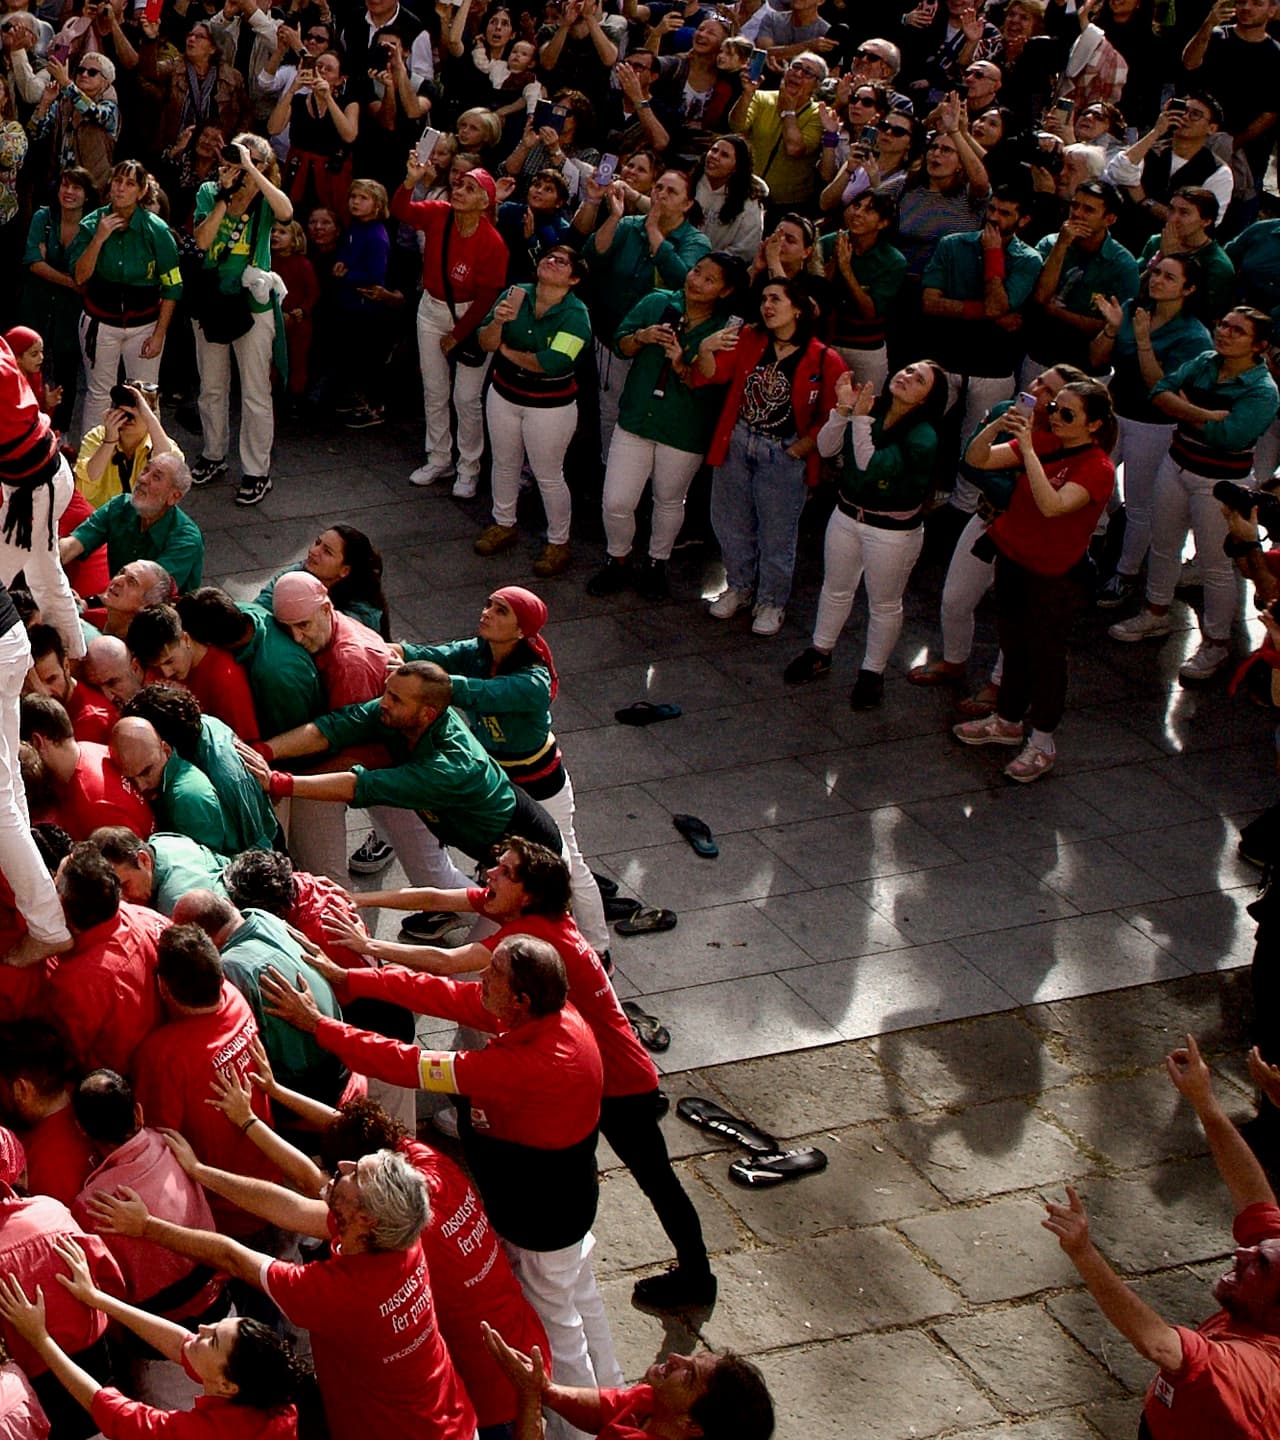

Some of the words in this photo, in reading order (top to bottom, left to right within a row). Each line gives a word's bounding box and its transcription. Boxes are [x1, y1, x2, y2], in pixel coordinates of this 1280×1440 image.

[457, 1235, 476, 1257] fer
[379, 1274, 419, 1318] nascuts
[391, 1312, 409, 1334] fer
